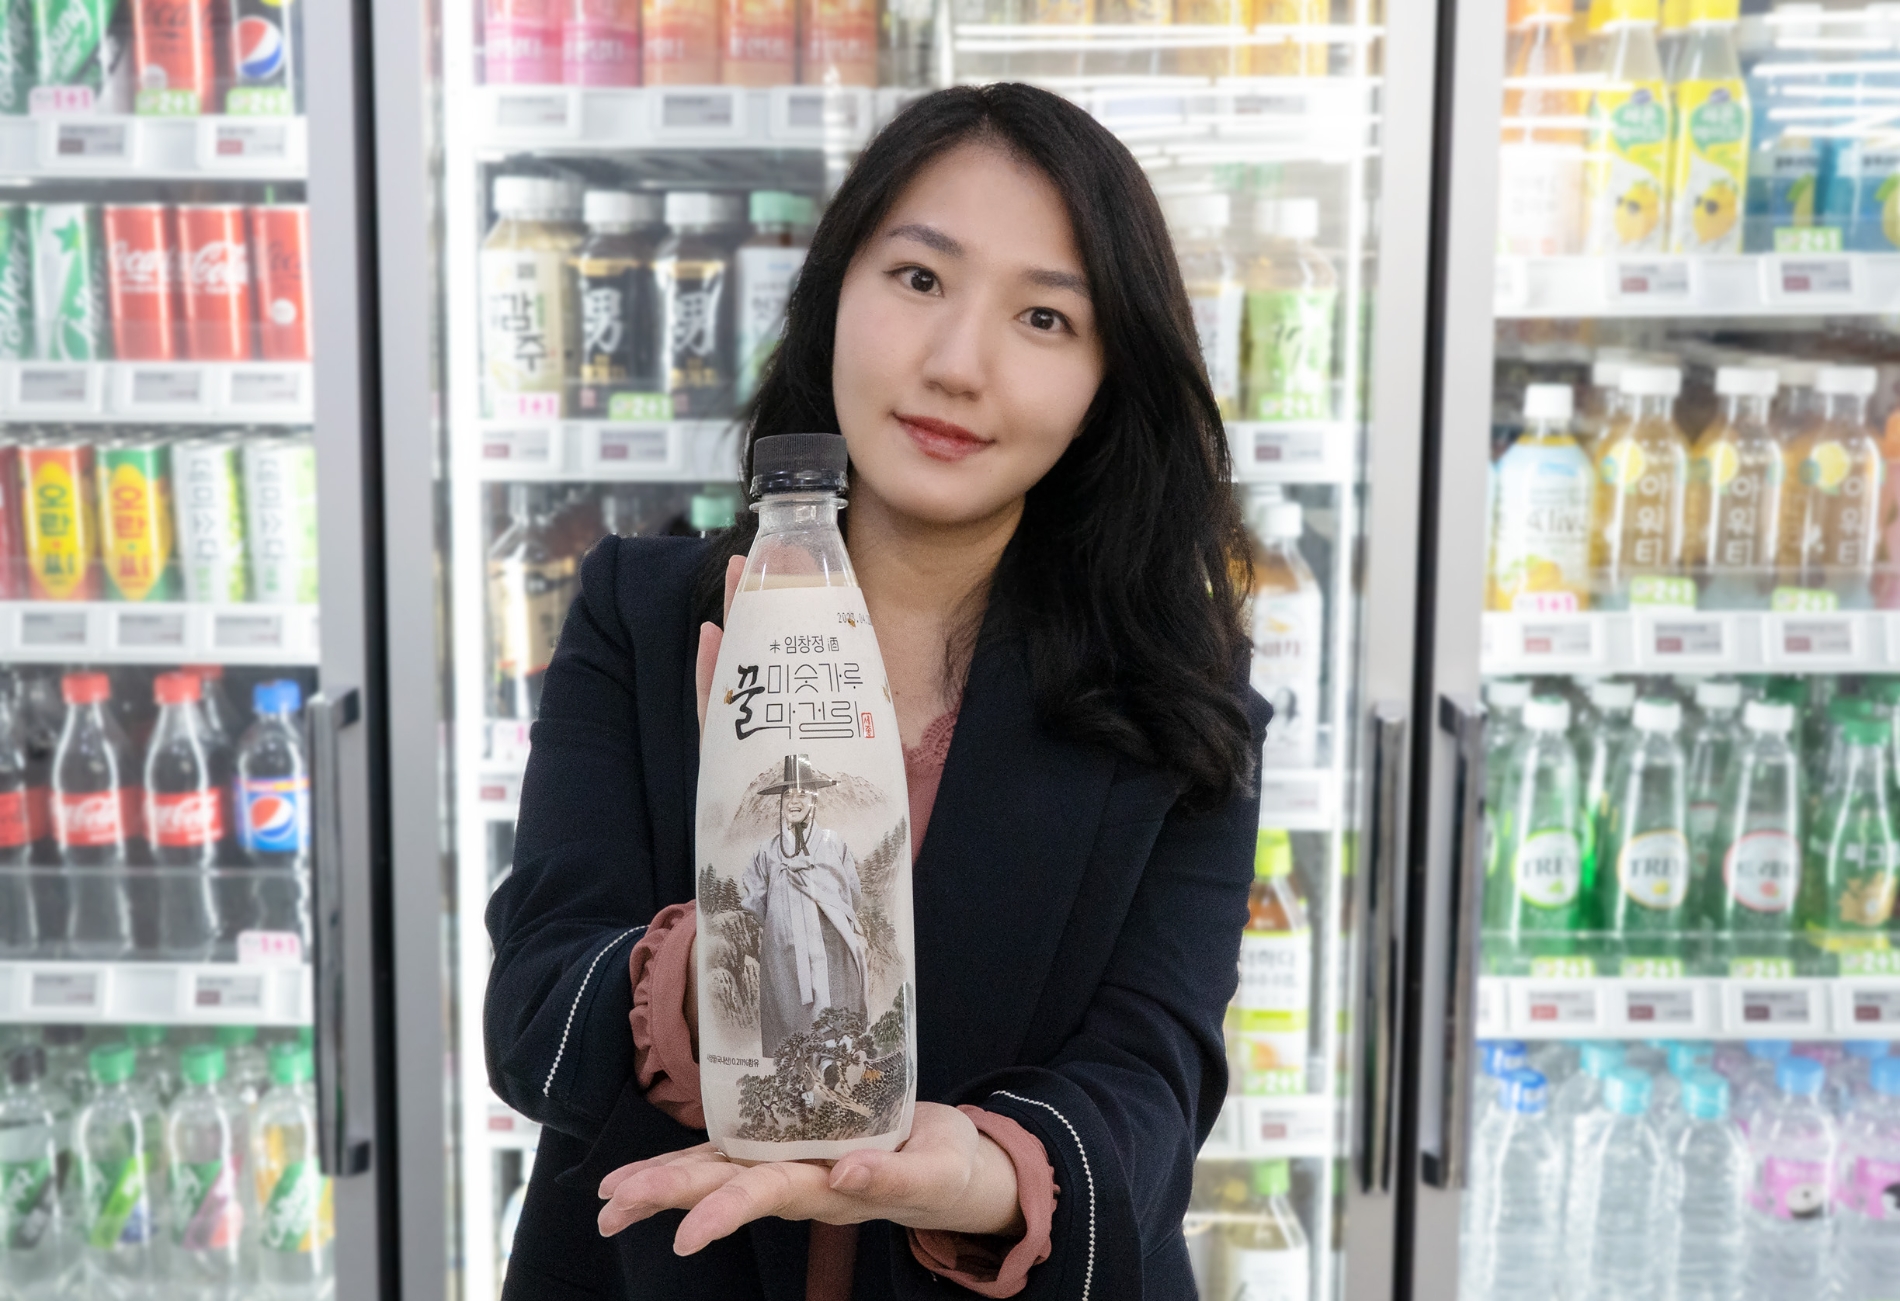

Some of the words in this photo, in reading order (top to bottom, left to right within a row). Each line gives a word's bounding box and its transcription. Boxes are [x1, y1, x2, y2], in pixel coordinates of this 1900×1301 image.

[582, 287, 622, 352] 男
[519, 394, 555, 414] 1+1
[37, 484, 75, 575] 오란씨
[114, 486, 151, 578] 오란씨
[1537, 593, 1573, 612] 1+1
[1654, 580, 1692, 600] 2+1
[784, 634, 825, 654] 임창정
[729, 664, 766, 741] 꿀
[767, 662, 864, 694] 미숫가루
[765, 700, 861, 740] 막걸리
[261, 935, 297, 953] 1+1
